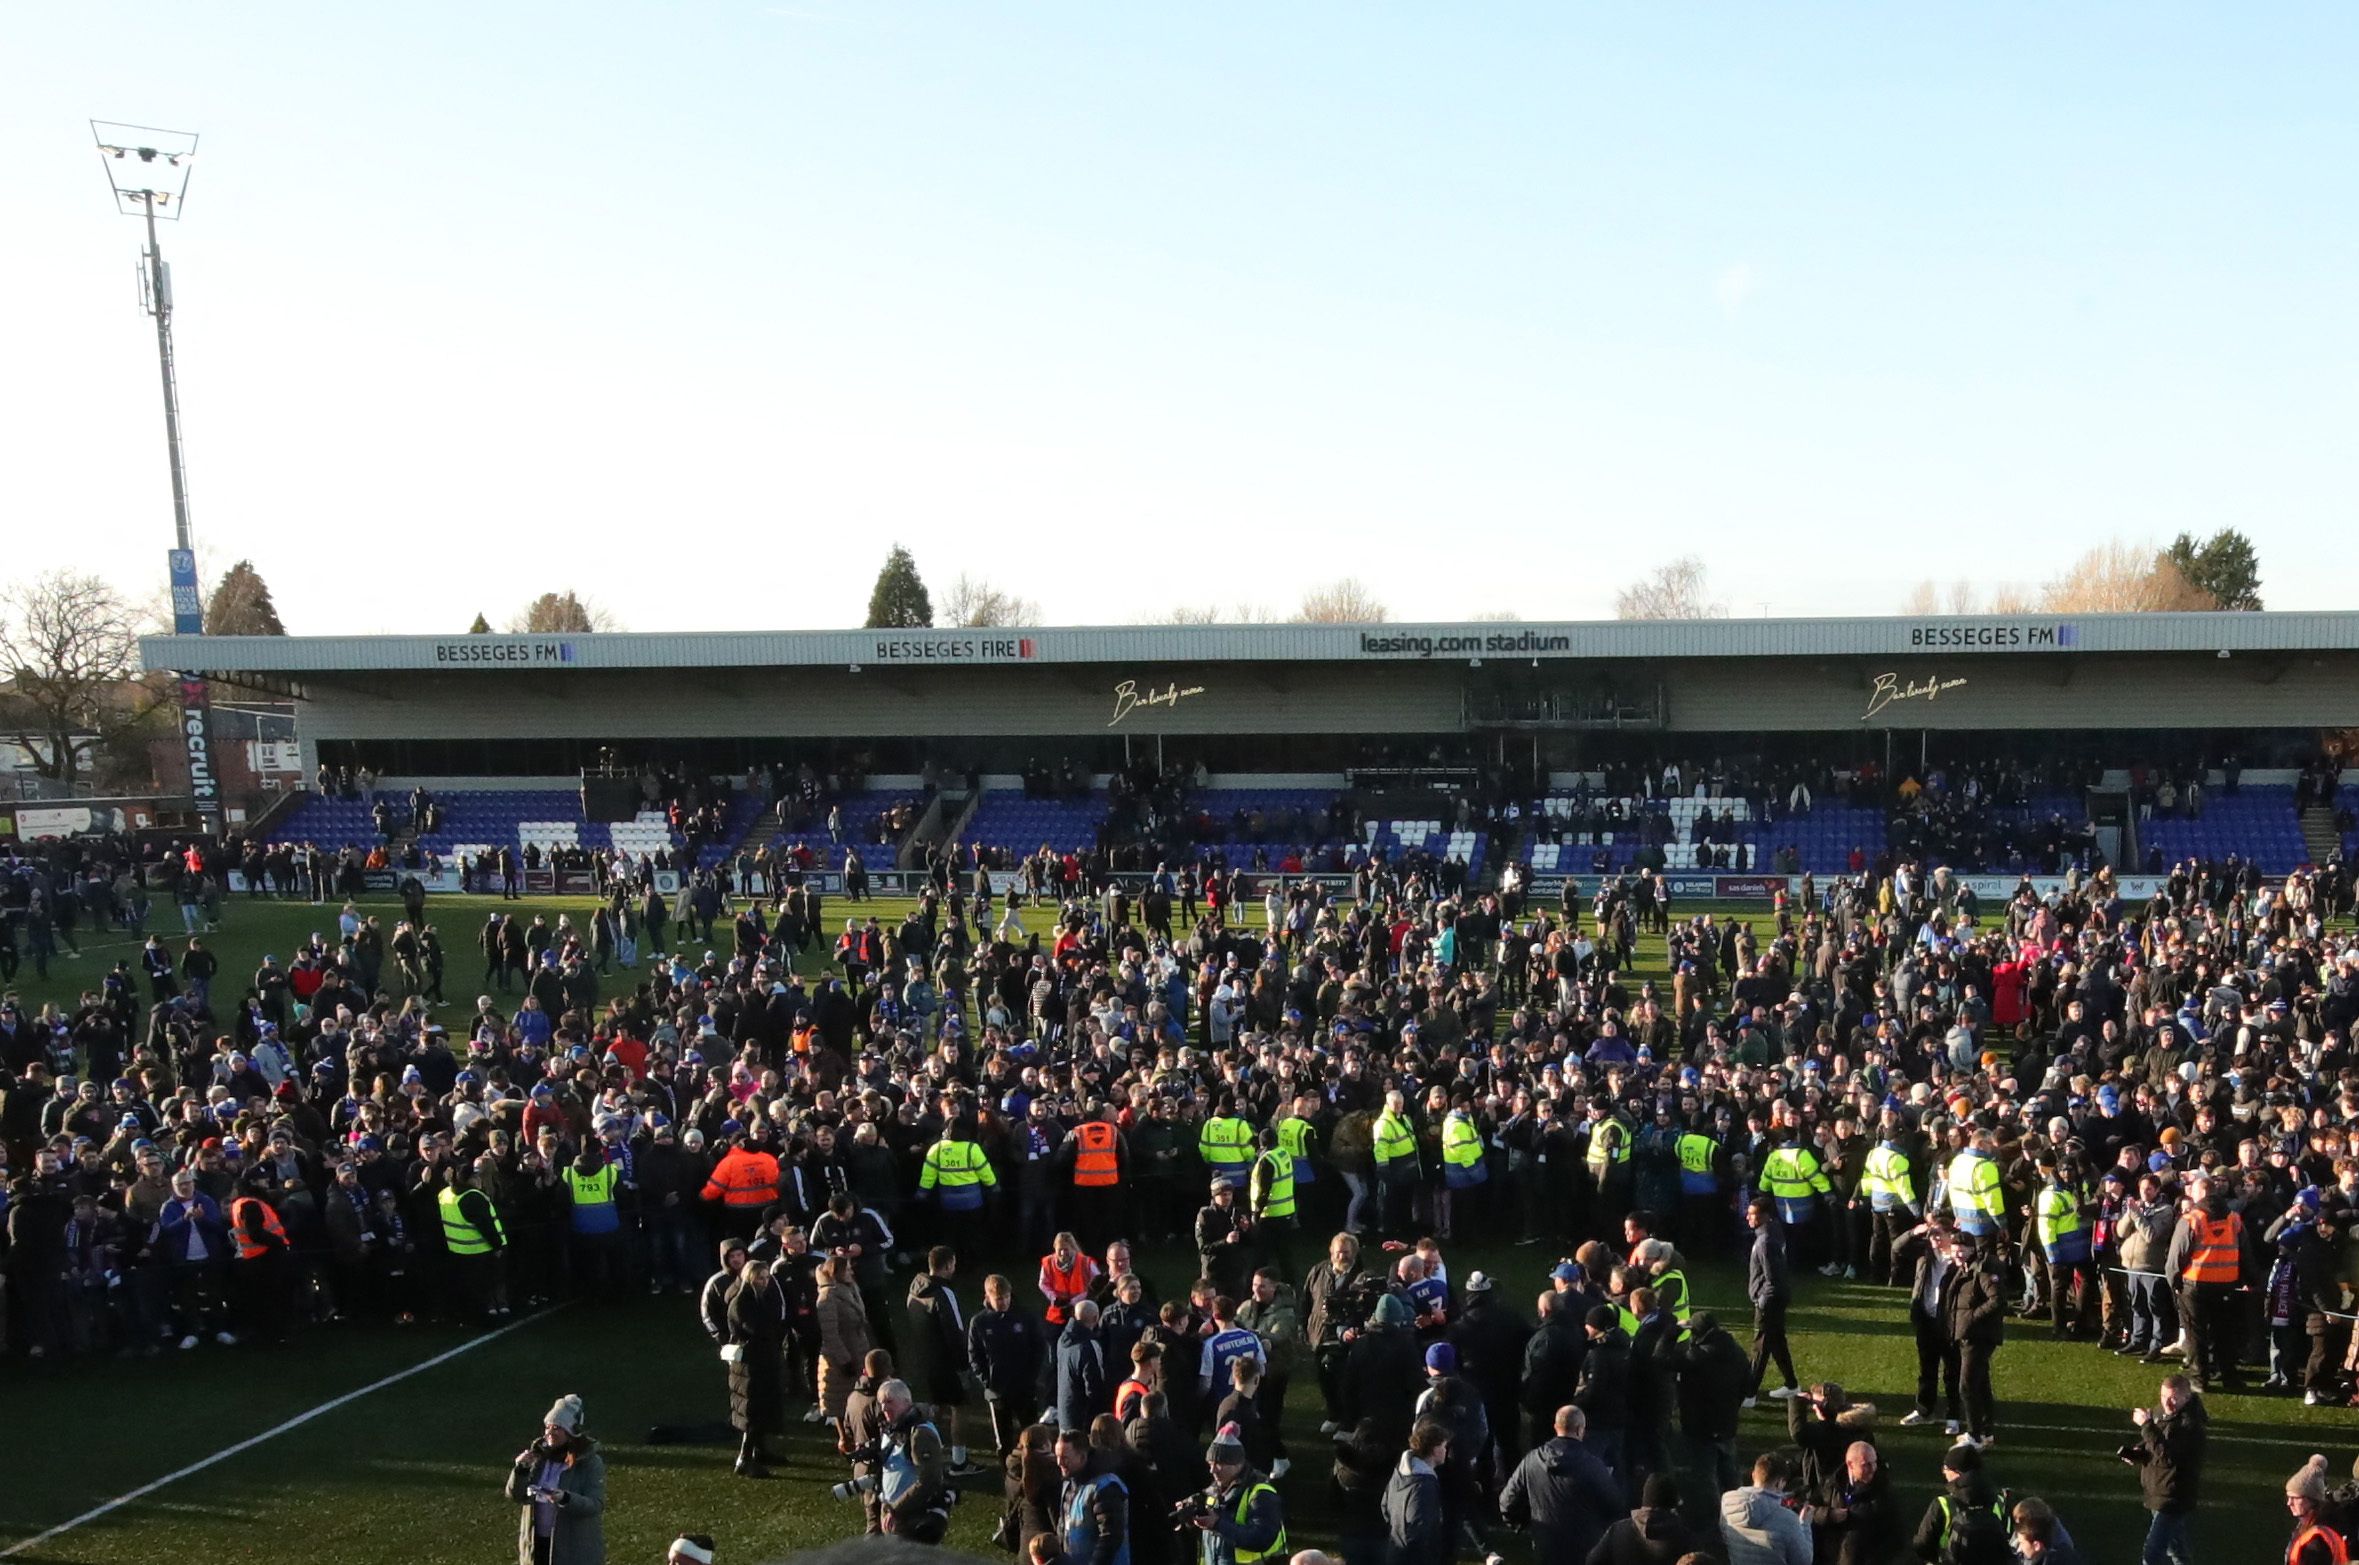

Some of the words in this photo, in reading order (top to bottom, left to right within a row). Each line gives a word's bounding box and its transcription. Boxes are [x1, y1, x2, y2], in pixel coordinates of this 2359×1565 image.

[1361, 632, 1482, 657] leasing.com
[1486, 631, 1569, 650] stadium
[1911, 628, 2020, 646] BESSEGES
[2028, 627, 2054, 645] FM
[436, 645, 530, 662] BESSEGES
[535, 645, 557, 661] FM
[876, 641, 974, 659] BESSEGES
[982, 640, 1016, 657] FIRE
[185, 708, 216, 798] recruit
[579, 1183, 600, 1193] 793
